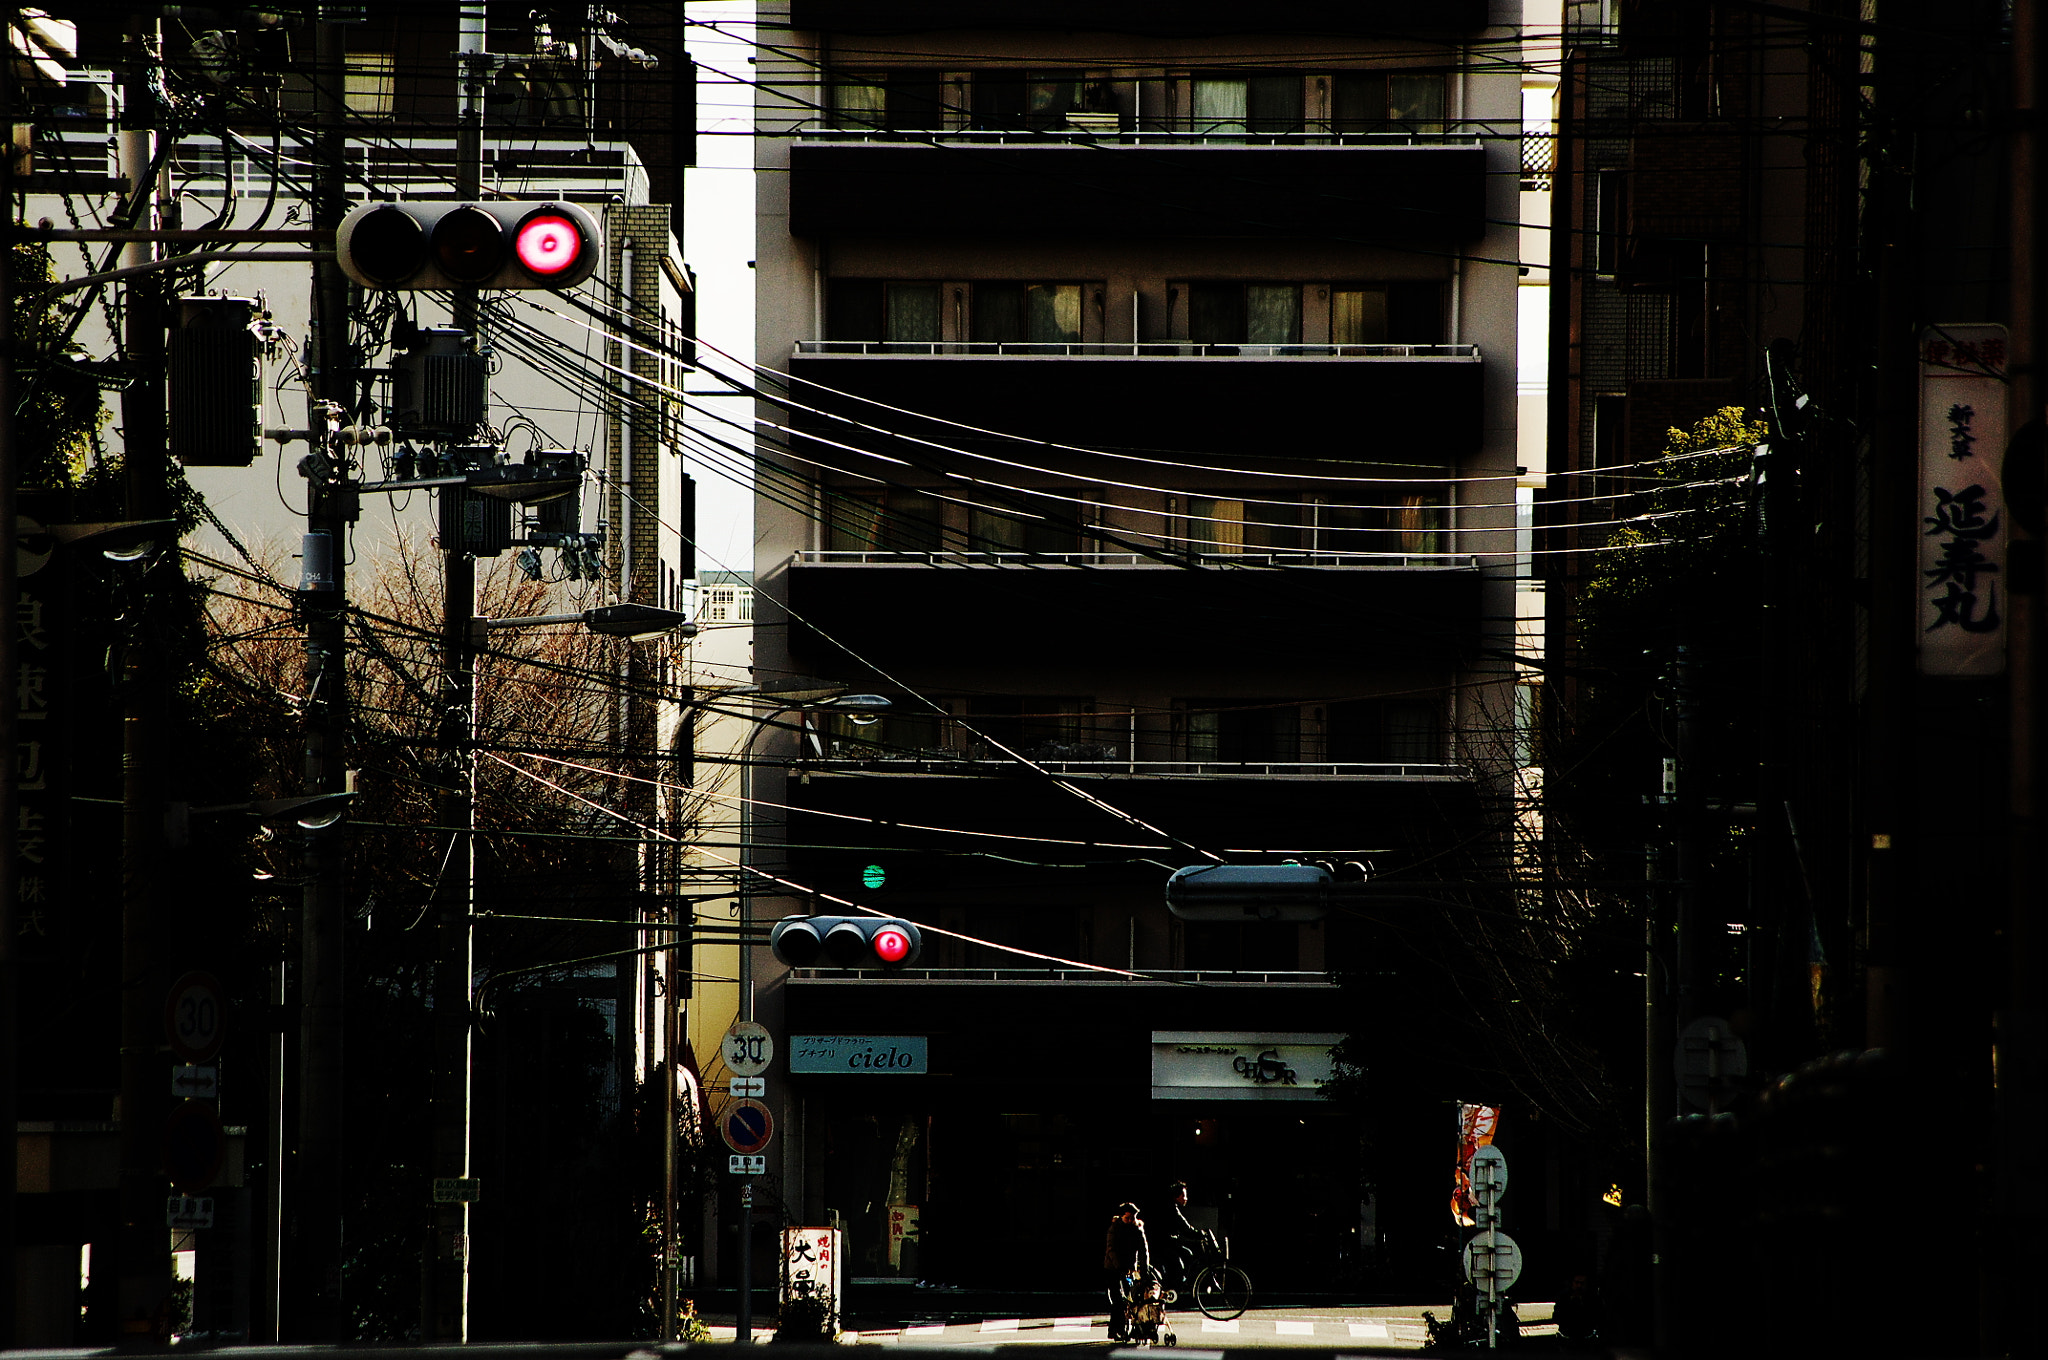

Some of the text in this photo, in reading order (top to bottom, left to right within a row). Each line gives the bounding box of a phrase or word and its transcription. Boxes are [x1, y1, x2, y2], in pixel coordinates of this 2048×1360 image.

[1924, 485, 1999, 633] 延寿丸
[180, 999, 215, 1036] 30
[733, 1036, 766, 1065] 30
[848, 1047, 914, 1068] cielo
[731, 1156, 764, 1166] 自動車
[169, 1198, 213, 1214] 自動車
[817, 1235, 830, 1269] 焼肉の
